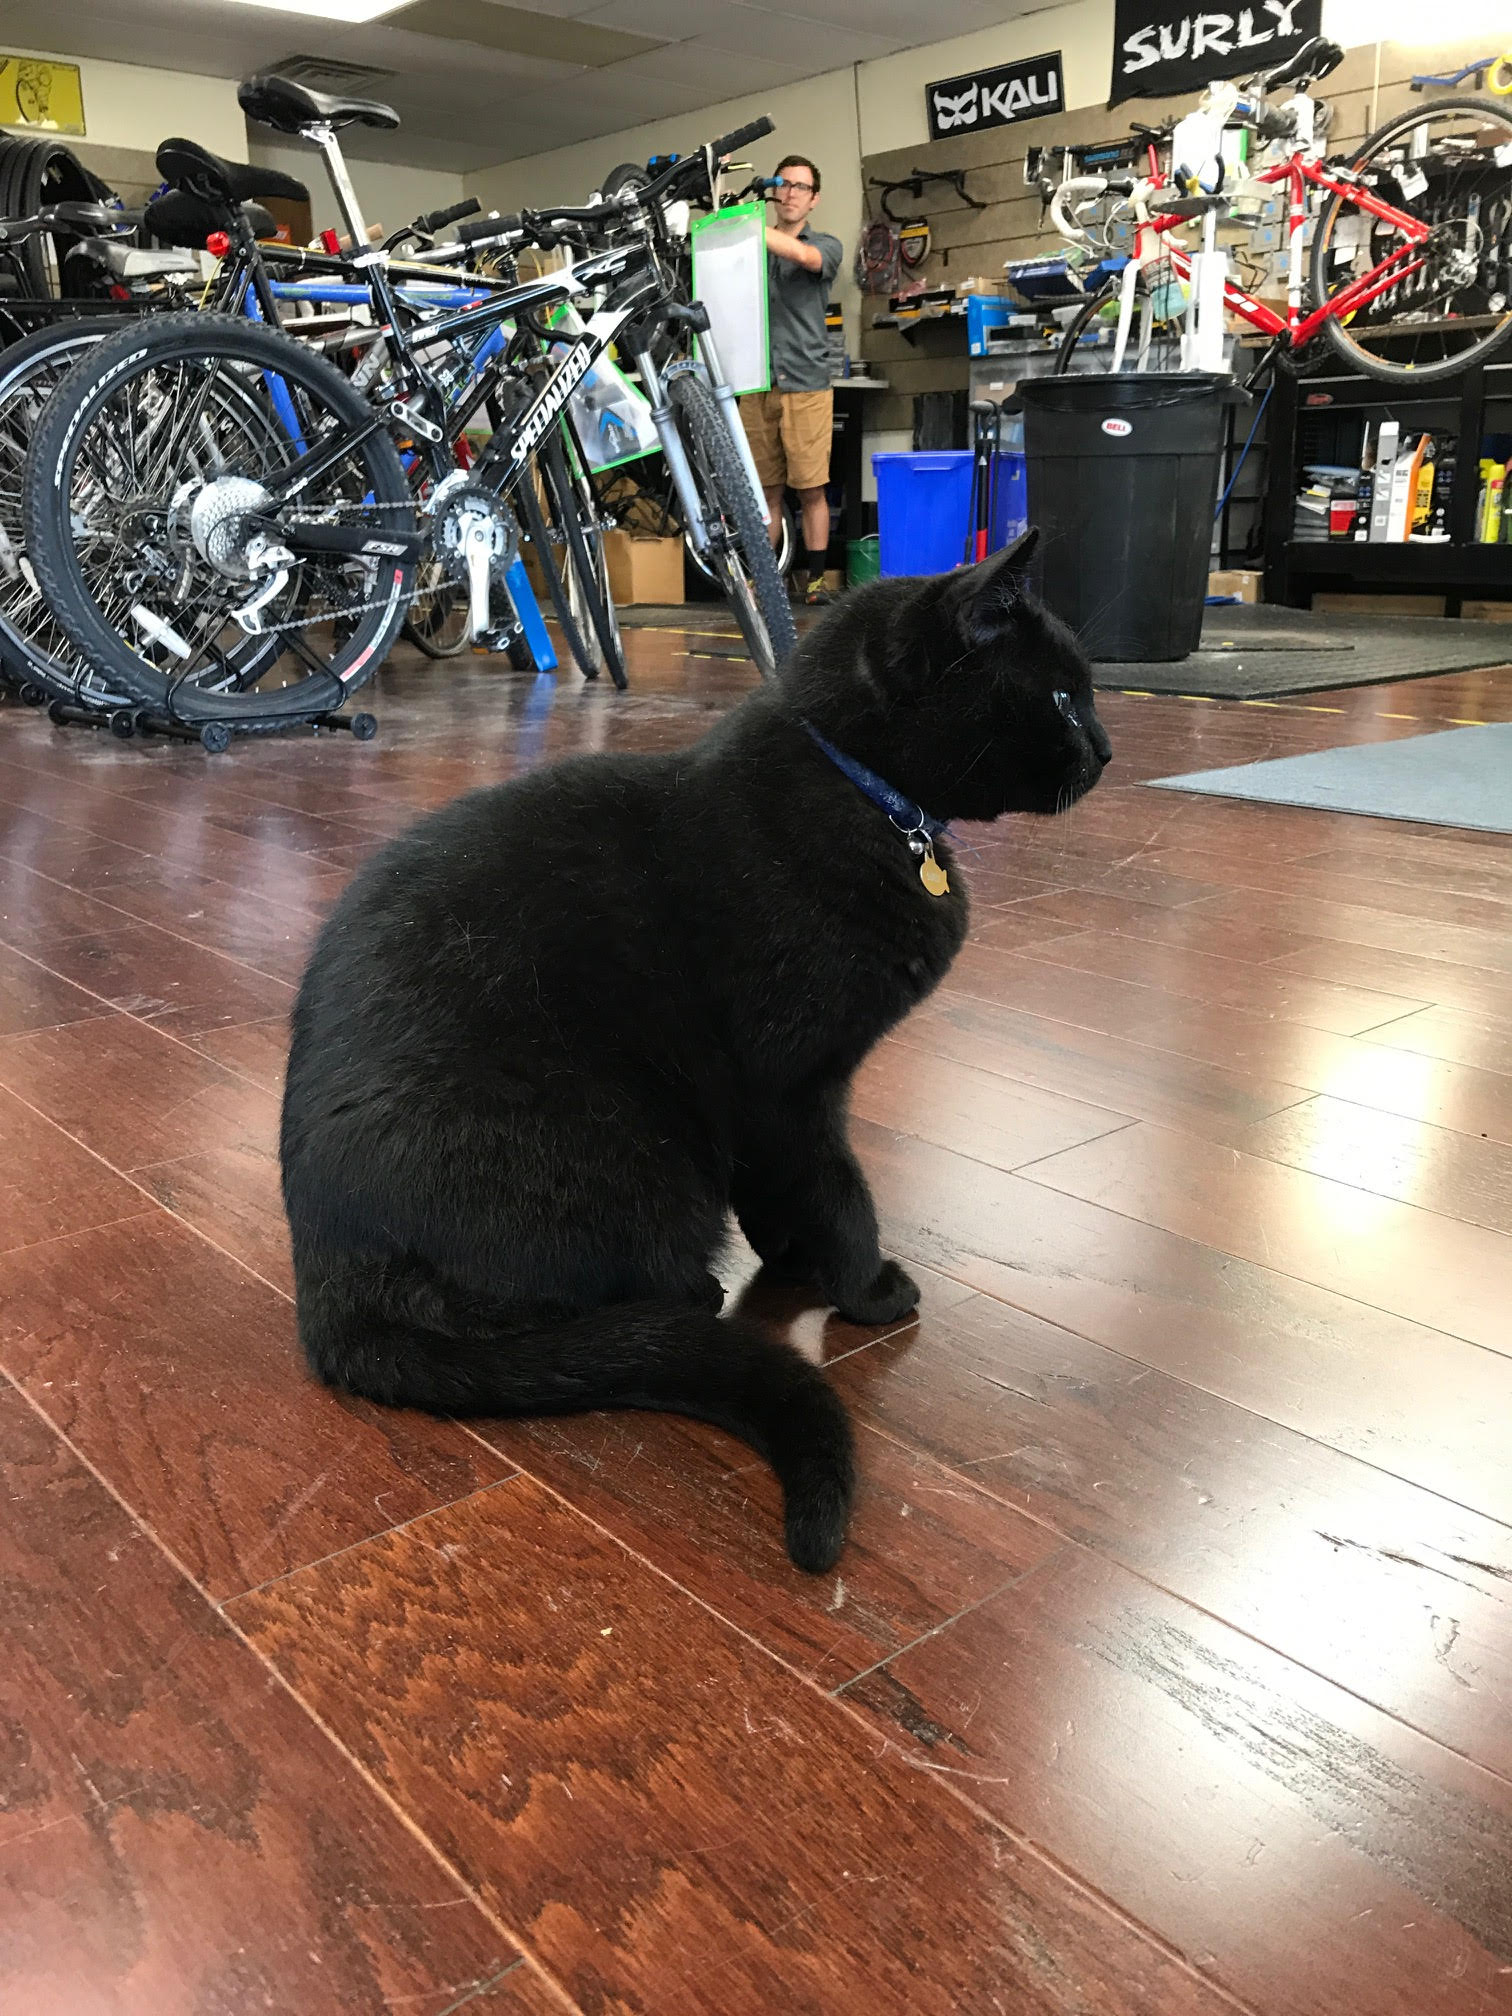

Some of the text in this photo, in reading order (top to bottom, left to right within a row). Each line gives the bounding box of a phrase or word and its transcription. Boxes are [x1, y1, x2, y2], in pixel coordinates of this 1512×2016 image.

[981, 70, 1058, 119] KALI
[54, 348, 148, 489] SPECIALIZED
[510, 341, 592, 470] SPECIALIZED
[1106, 422, 1126, 432] BELL
